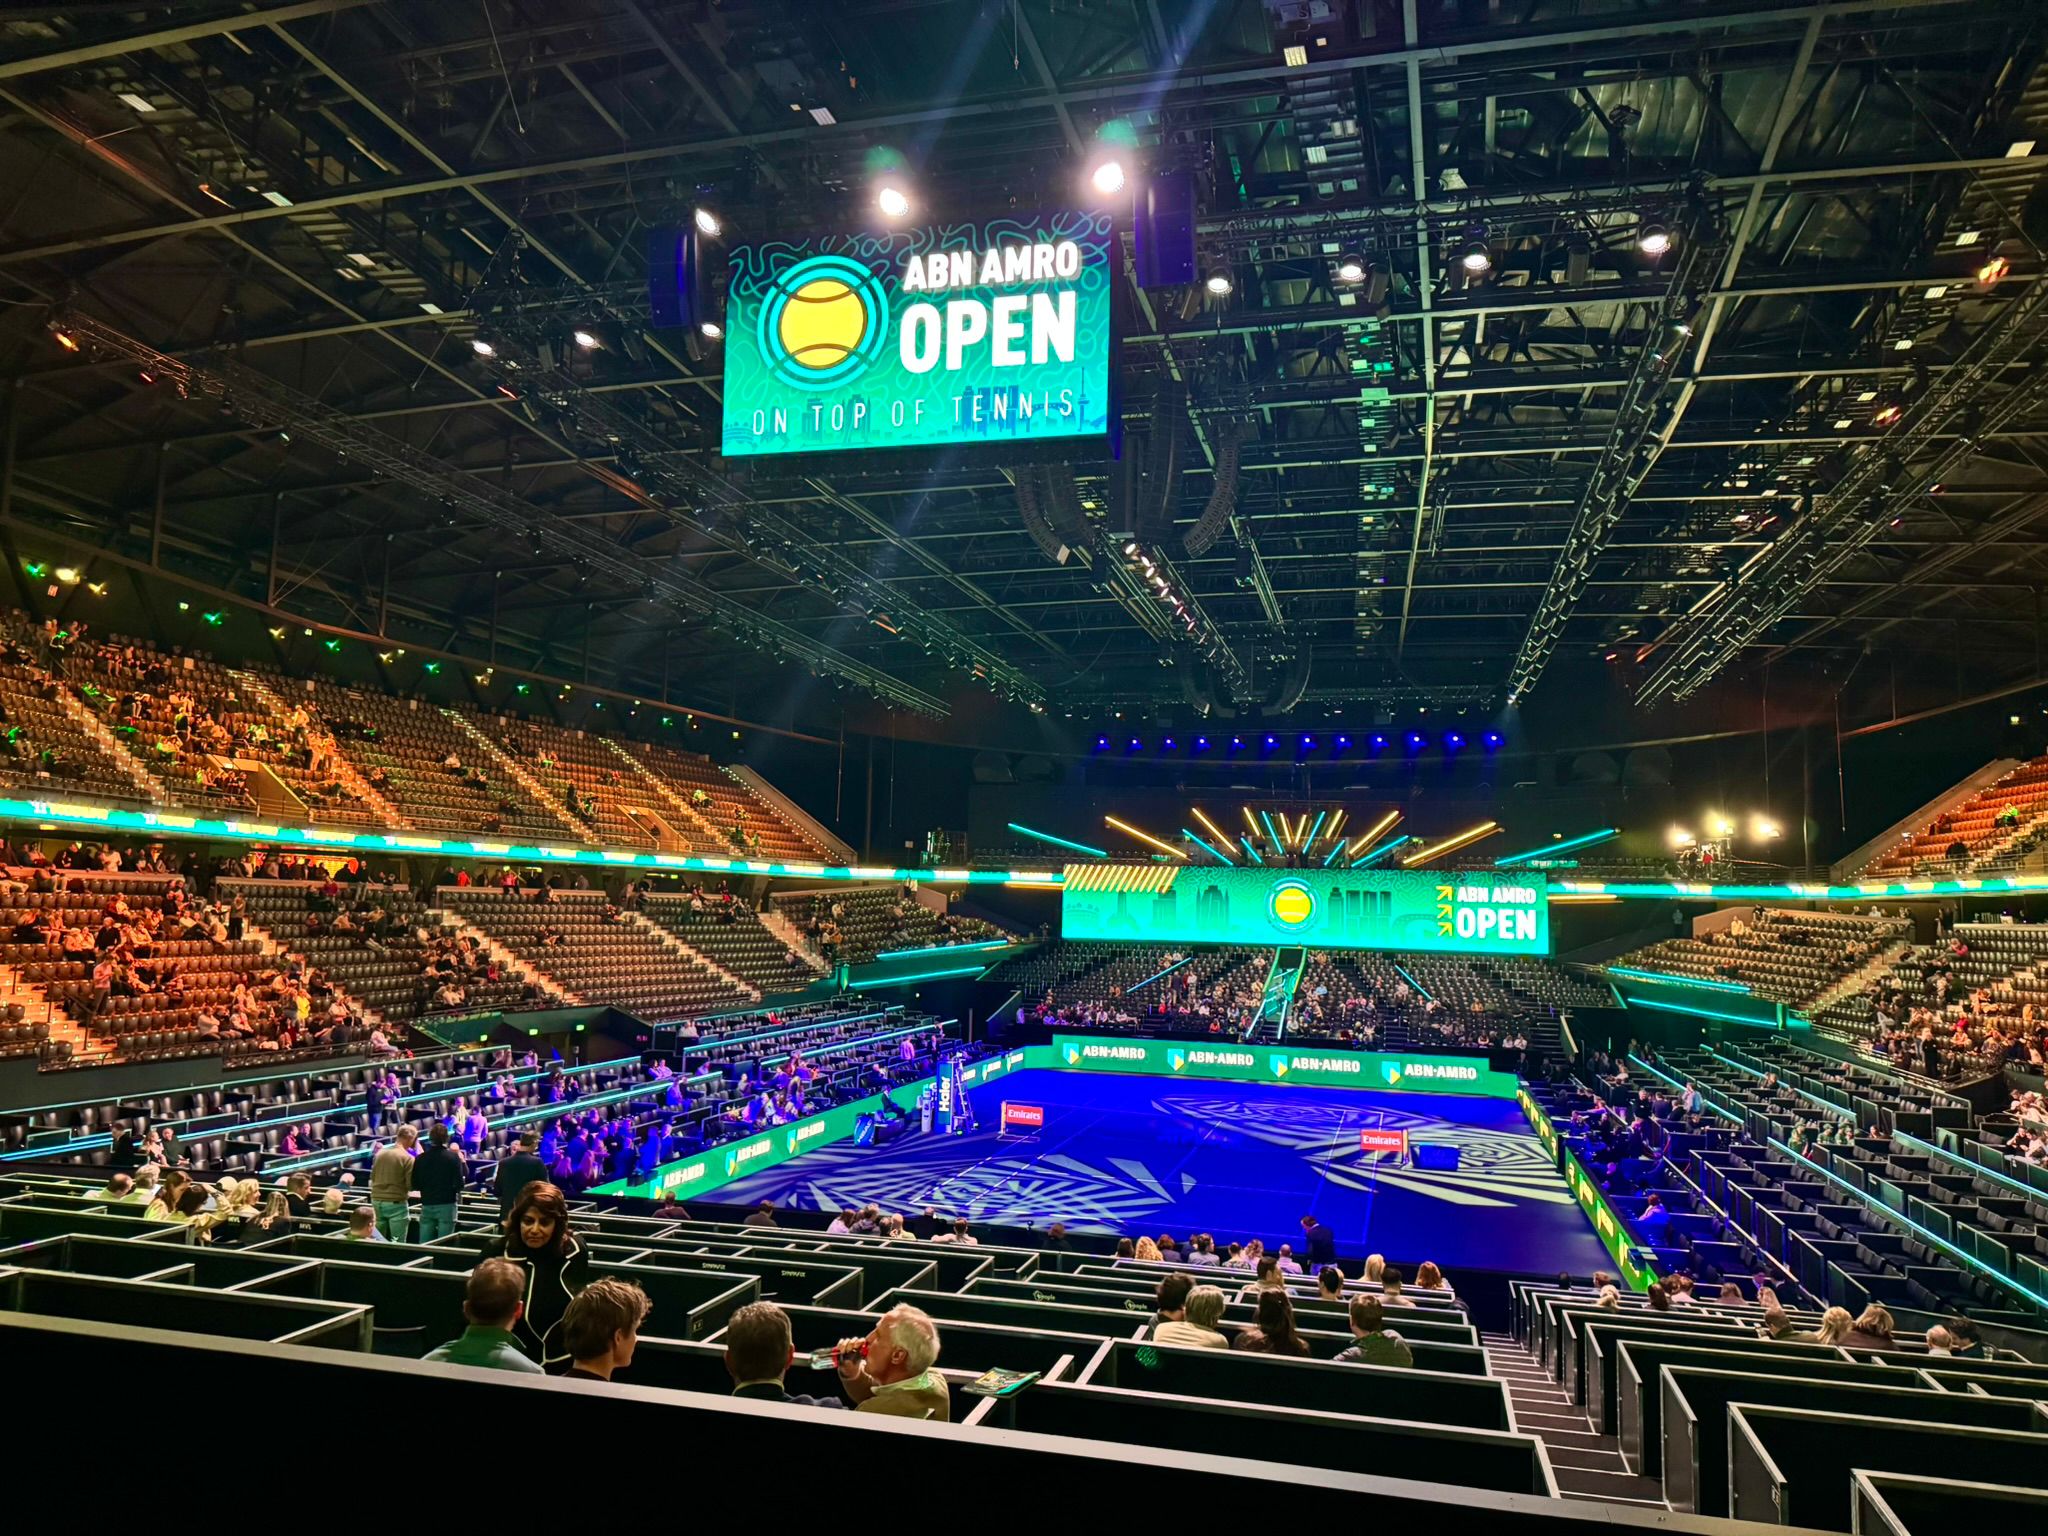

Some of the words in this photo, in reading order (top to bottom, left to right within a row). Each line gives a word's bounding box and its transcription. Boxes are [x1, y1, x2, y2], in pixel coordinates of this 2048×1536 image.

[902, 250, 974, 291] ABN
[979, 240, 1079, 285] AMRO
[900, 290, 1077, 374] OPEN
[752, 407, 788, 435] ON
[811, 402, 866, 432] TOP
[892, 399, 925, 427] OF
[951, 388, 1074, 423] TENNIS
[1457, 886, 1489, 903] ABN
[1491, 887, 1536, 904] AMRO
[1456, 907, 1537, 940] OPEN
[939, 1077, 951, 1112] Haier
[1008, 1109, 1041, 1121] Emirates
[1363, 1135, 1401, 1146] Emirates
